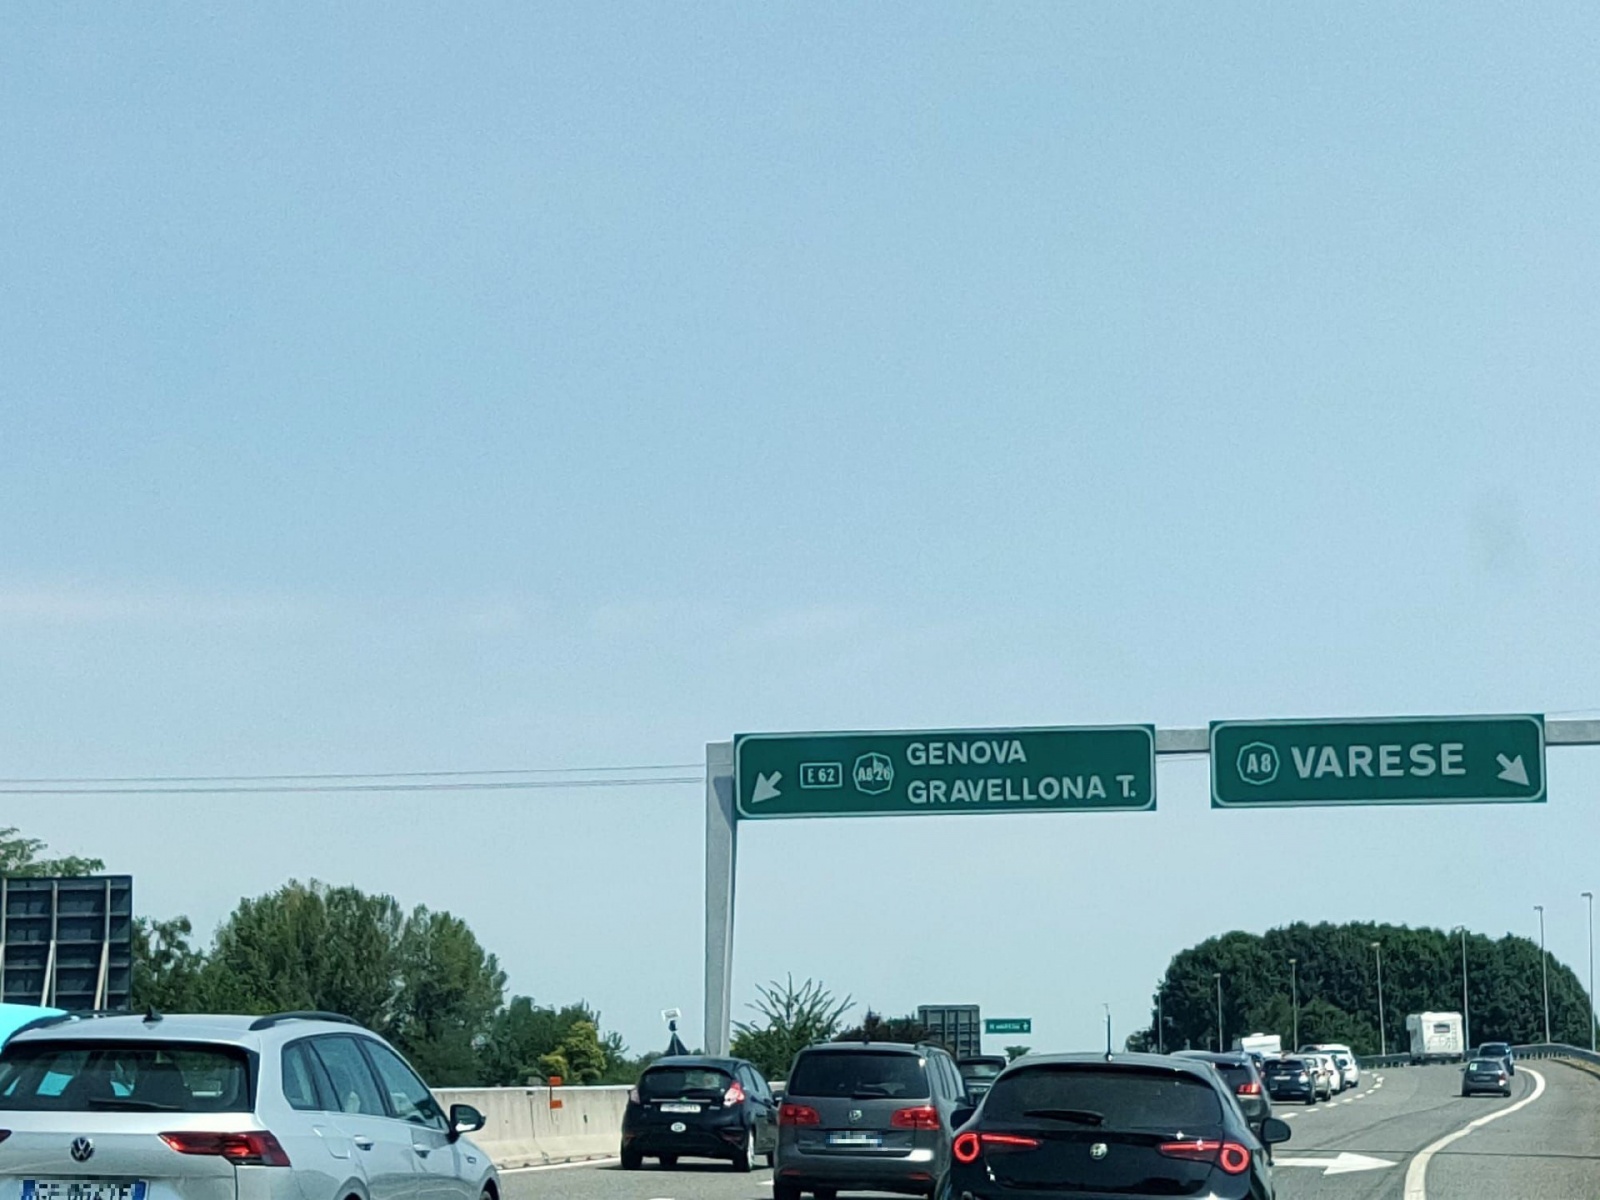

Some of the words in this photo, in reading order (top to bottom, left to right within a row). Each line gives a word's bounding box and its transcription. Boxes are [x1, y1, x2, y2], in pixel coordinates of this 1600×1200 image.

[906, 740, 1027, 766] GENOVA
[1245, 752, 1272, 775] A8
[1290, 742, 1467, 779] VARESE
[807, 767, 815, 783] E
[818, 767, 835, 783] 62
[906, 774, 1107, 805] GRAVELLONA
[1116, 774, 1136, 799] T.
